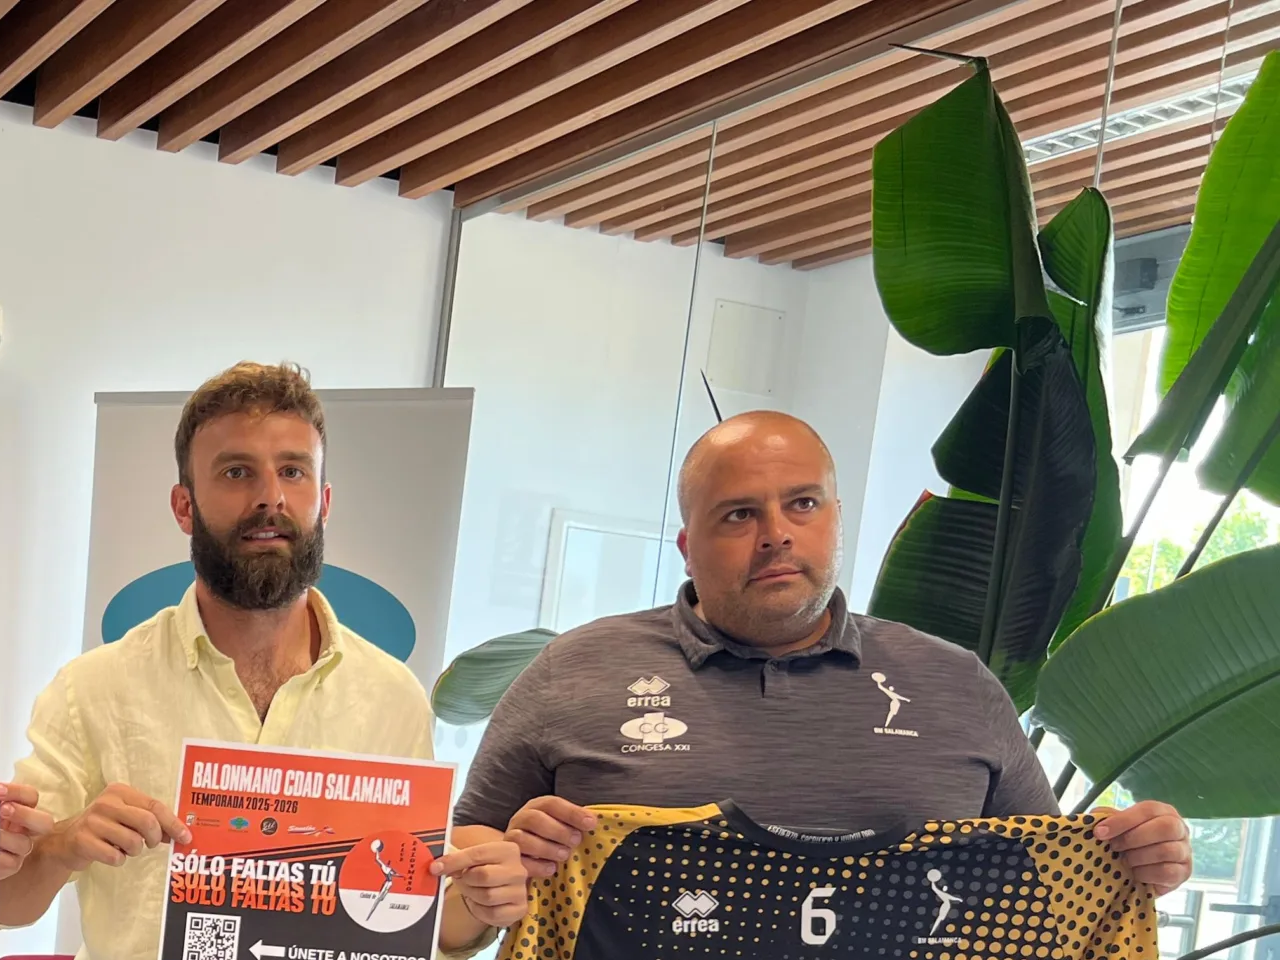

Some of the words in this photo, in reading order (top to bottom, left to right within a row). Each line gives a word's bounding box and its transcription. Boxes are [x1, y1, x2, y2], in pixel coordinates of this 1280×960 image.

[639, 722, 669, 734] CG
[621, 744, 672, 753] CONGESA
[191, 761, 283, 796] BALONMANO
[283, 769, 324, 799] CDAD
[324, 773, 411, 807] SALAMANCA
[191, 791, 244, 809] TEMPORADA
[245, 796, 299, 814] 2025-2026
[170, 849, 225, 876] SÓLO
[231, 857, 305, 883] FALTAS
[309, 860, 337, 886] TÚ
[801, 887, 837, 945] 6
